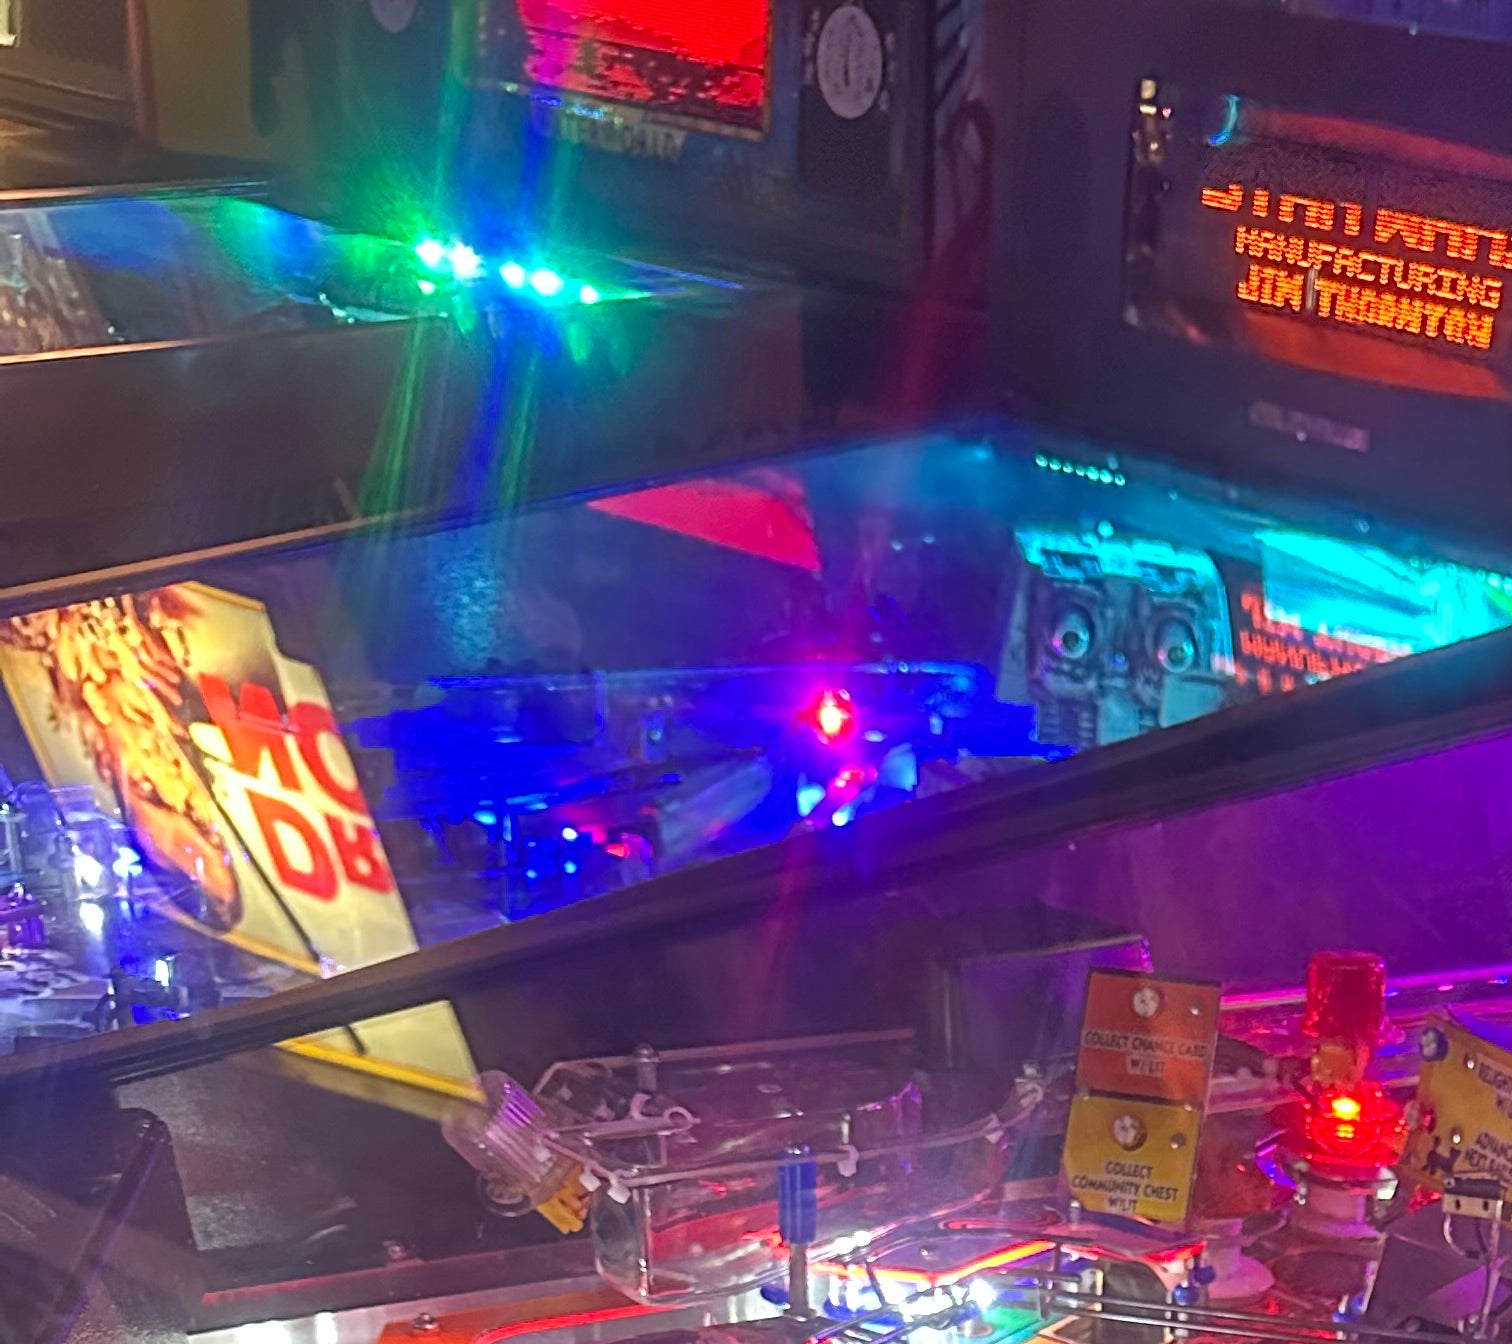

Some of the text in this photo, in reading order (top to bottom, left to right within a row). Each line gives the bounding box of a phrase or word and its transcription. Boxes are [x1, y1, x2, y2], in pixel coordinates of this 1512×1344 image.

[1234, 225, 1502, 310] MANUFACTURING
[1236, 263, 1304, 312] JIM
[1104, 1159, 1153, 1179] COLLECT
[1071, 1175, 1180, 1202] COMMUNITY CHEST
